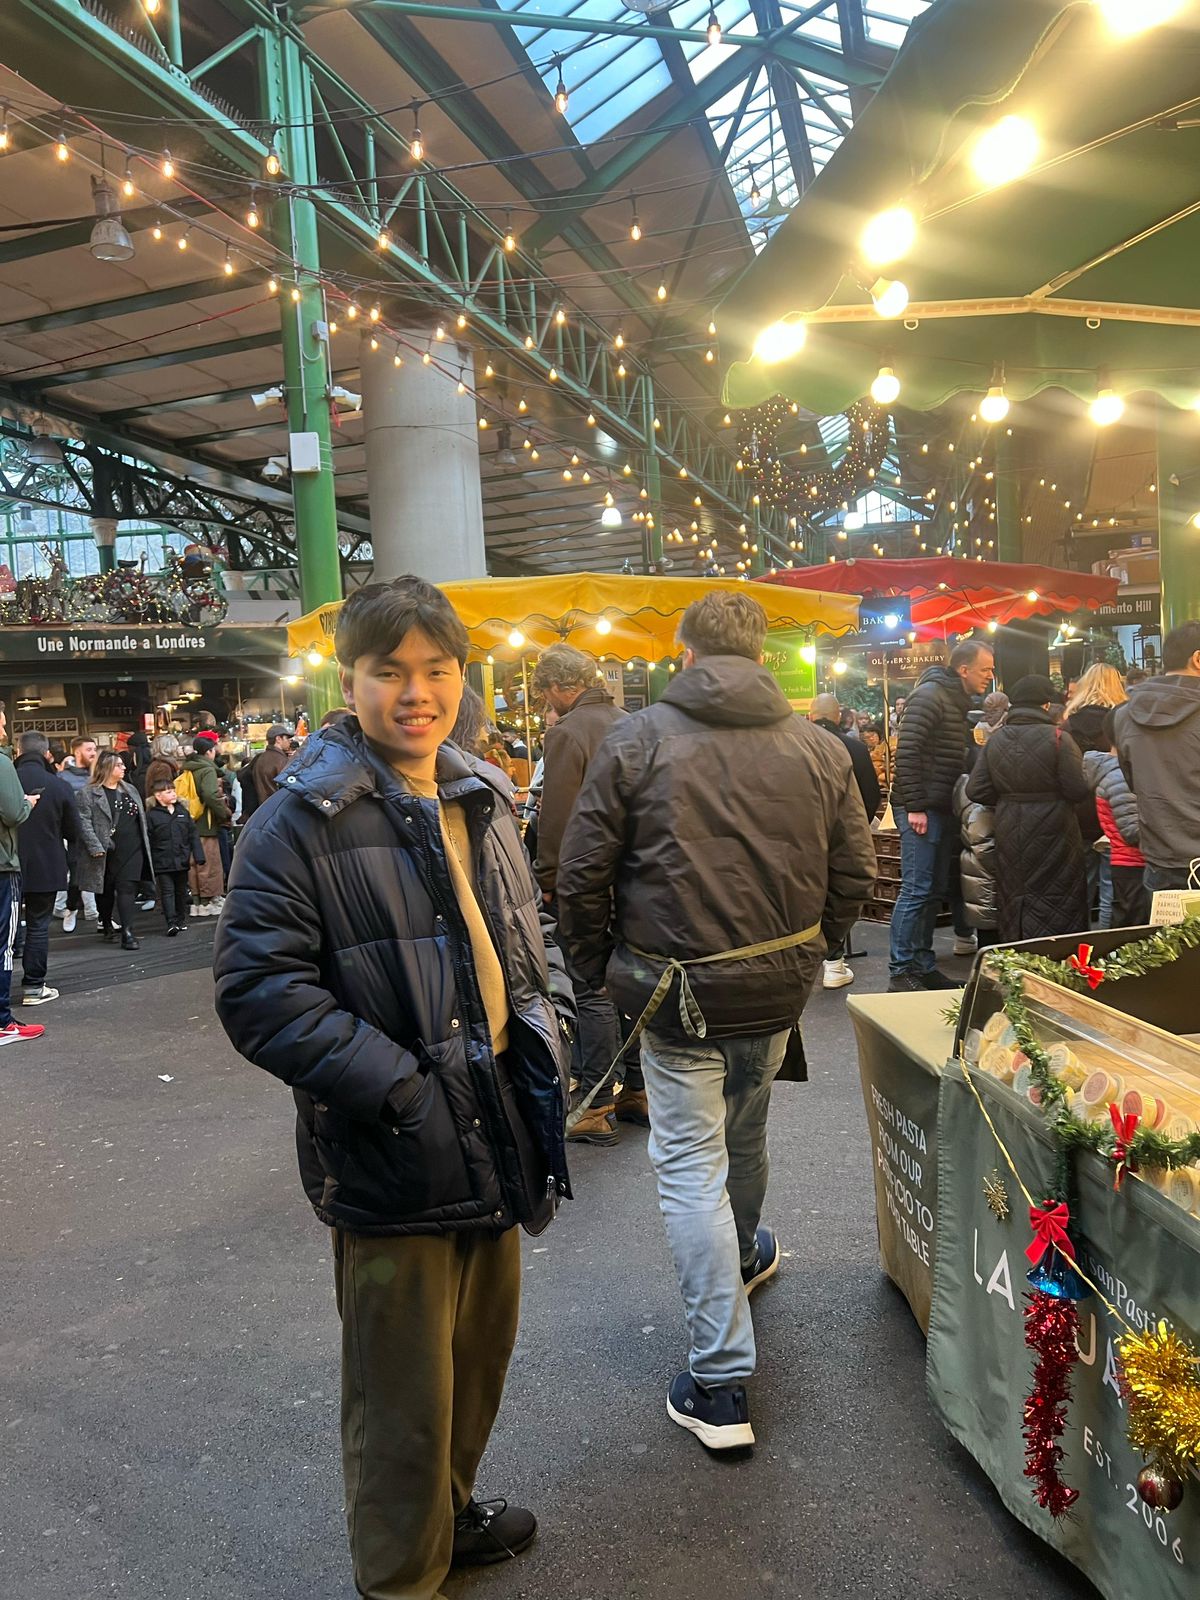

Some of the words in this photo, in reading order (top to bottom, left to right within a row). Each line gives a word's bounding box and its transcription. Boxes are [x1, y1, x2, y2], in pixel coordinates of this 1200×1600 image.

[863, 614, 903, 625] BAKY
[1093, 602, 1132, 615] imento
[1136, 600, 1152, 612] Hill
[37, 637, 63, 651] Une
[69, 636, 137, 651] Normande
[143, 639, 150, 649] a
[155, 634, 206, 649] Londres
[872, 656, 911, 665] OLER'S
[913, 655, 945, 663] BAKERY
[895, 1110, 927, 1155] PASTA
[900, 1149, 923, 1188] OUR
[915, 1198, 934, 1232] TO
[901, 1217, 930, 1267] TABLE
[974, 1228, 1015, 1311] LA
[1083, 1425, 1118, 1490] EST.
[1126, 1483, 1184, 1565] 2006
